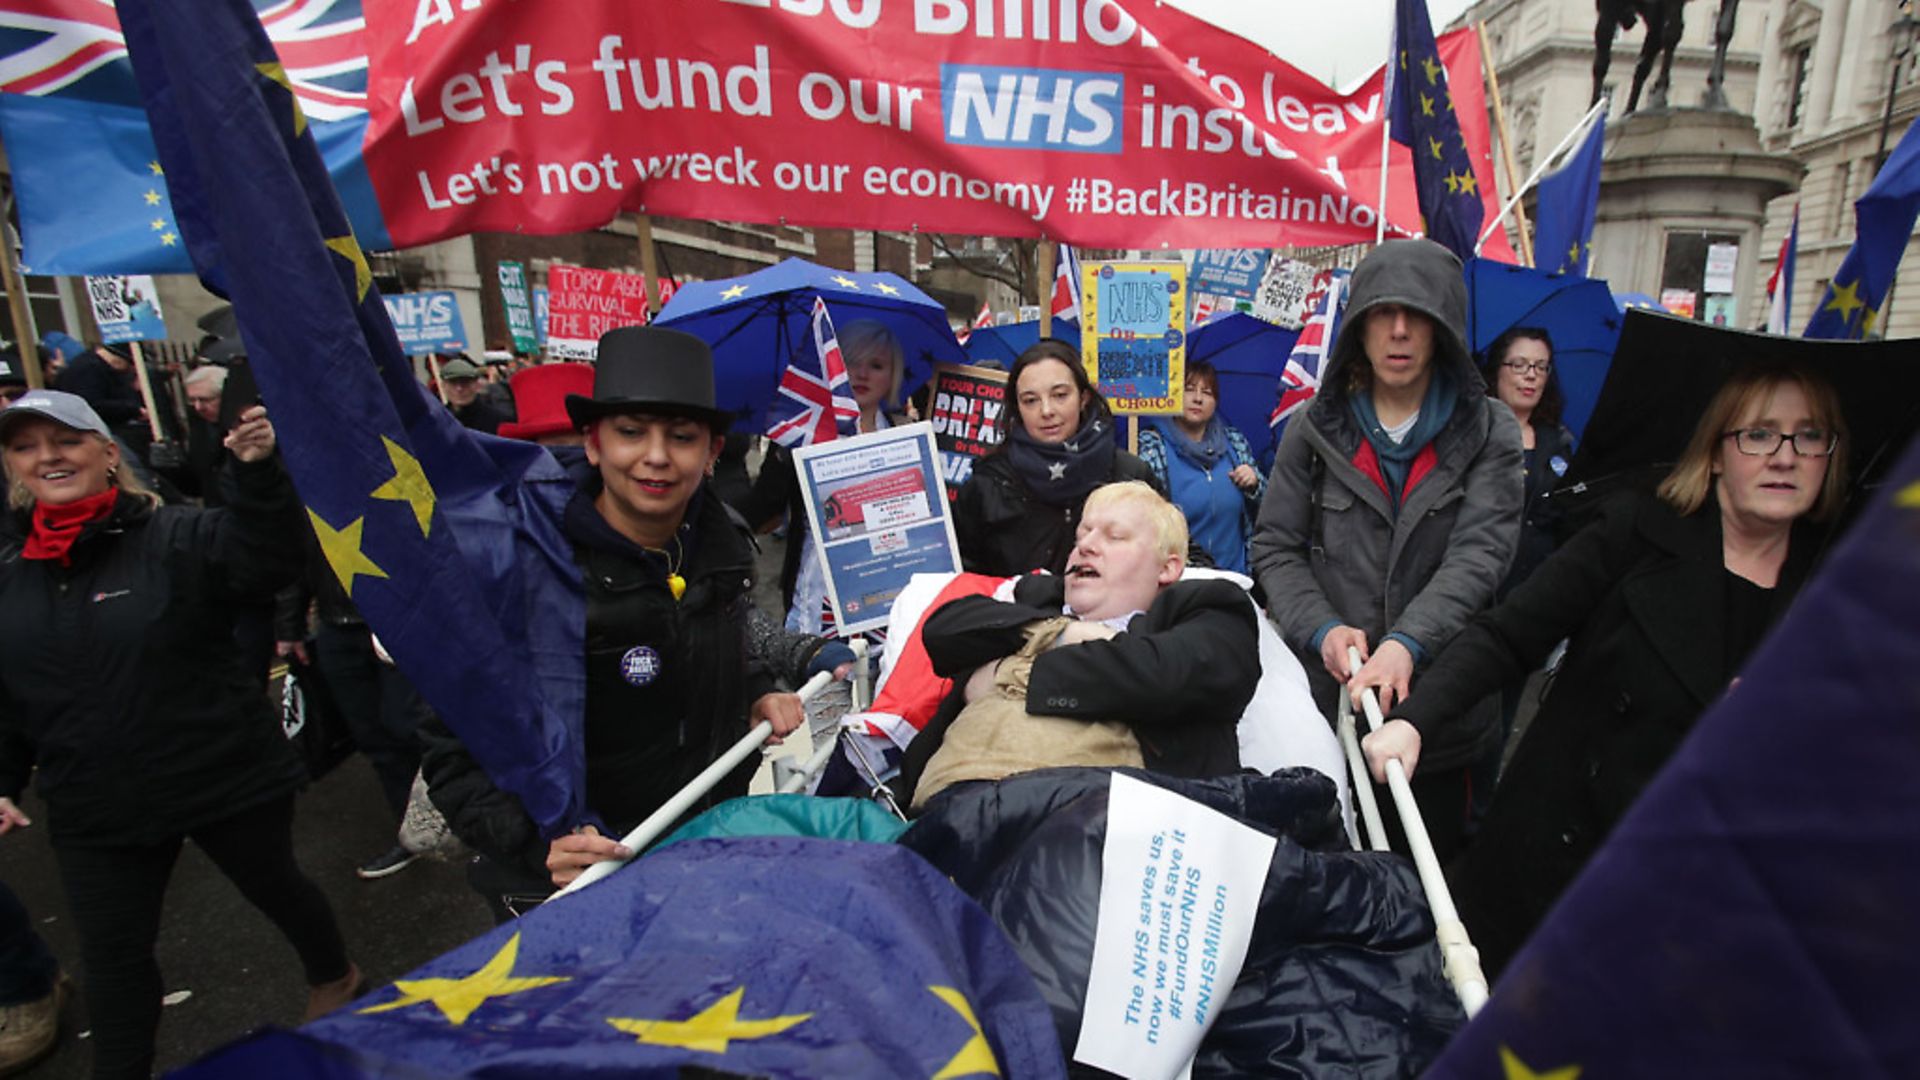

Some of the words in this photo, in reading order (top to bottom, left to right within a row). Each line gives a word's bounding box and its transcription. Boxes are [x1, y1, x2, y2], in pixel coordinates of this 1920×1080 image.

[399, 44, 575, 138] Let's
[592, 34, 773, 118] fund
[797, 71, 923, 132] our
[949, 71, 1120, 147] NHS
[1262, 71, 1382, 137] leav
[417, 156, 524, 211] Let's
[537, 152, 624, 195] not
[631, 146, 761, 188] wreck
[773, 161, 850, 193] our
[862, 165, 1054, 222] economy
[1066, 177, 1381, 230] #BackBritainNo
[91, 281, 119, 301] OUR
[551, 290, 632, 318] SURVIVAL
[557, 268, 605, 292] TORY
[612, 275, 674, 303] AGENA
[1108, 281, 1163, 325] NHS
[96, 300, 124, 320] NHS
[383, 295, 452, 326] NHS
[550, 312, 585, 337] THE
[1098, 351, 1169, 379] BREXIT
[941, 378, 976, 395] YOUR
[976, 384, 1005, 399] CHO
[933, 393, 1006, 445] BREX
[1171, 828, 1187, 845] it
[1164, 848, 1184, 897] save
[1140, 865, 1157, 926] saves
[1157, 900, 1173, 955] must
[1168, 866, 1202, 1021] #FundOurNHS
[1132, 930, 1150, 980] NHS
[1154, 959, 1168, 989] we
[1193, 884, 1228, 1026] #NHSMillion
[1125, 984, 1145, 1025] The
[1146, 994, 1164, 1045] now
